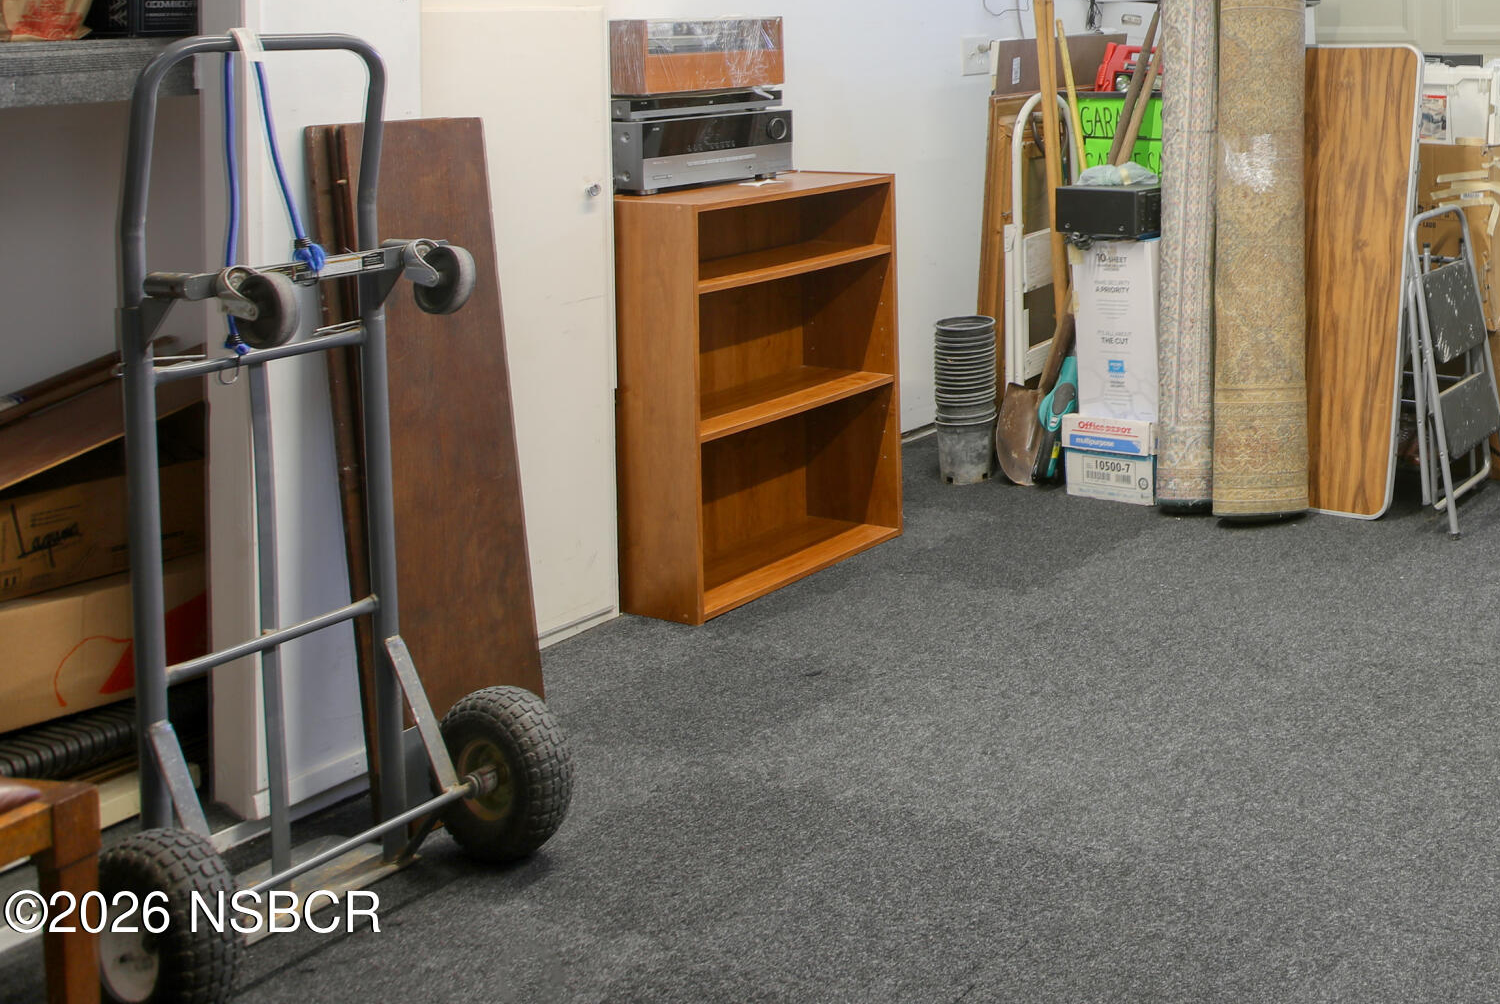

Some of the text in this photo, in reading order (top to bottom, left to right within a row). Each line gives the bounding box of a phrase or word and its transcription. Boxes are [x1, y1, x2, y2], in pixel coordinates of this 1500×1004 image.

[1080, 106, 1122, 137] GARA
[1078, 421, 1132, 434] Office DEPOT
[1095, 459, 1131, 473] 10500-7
